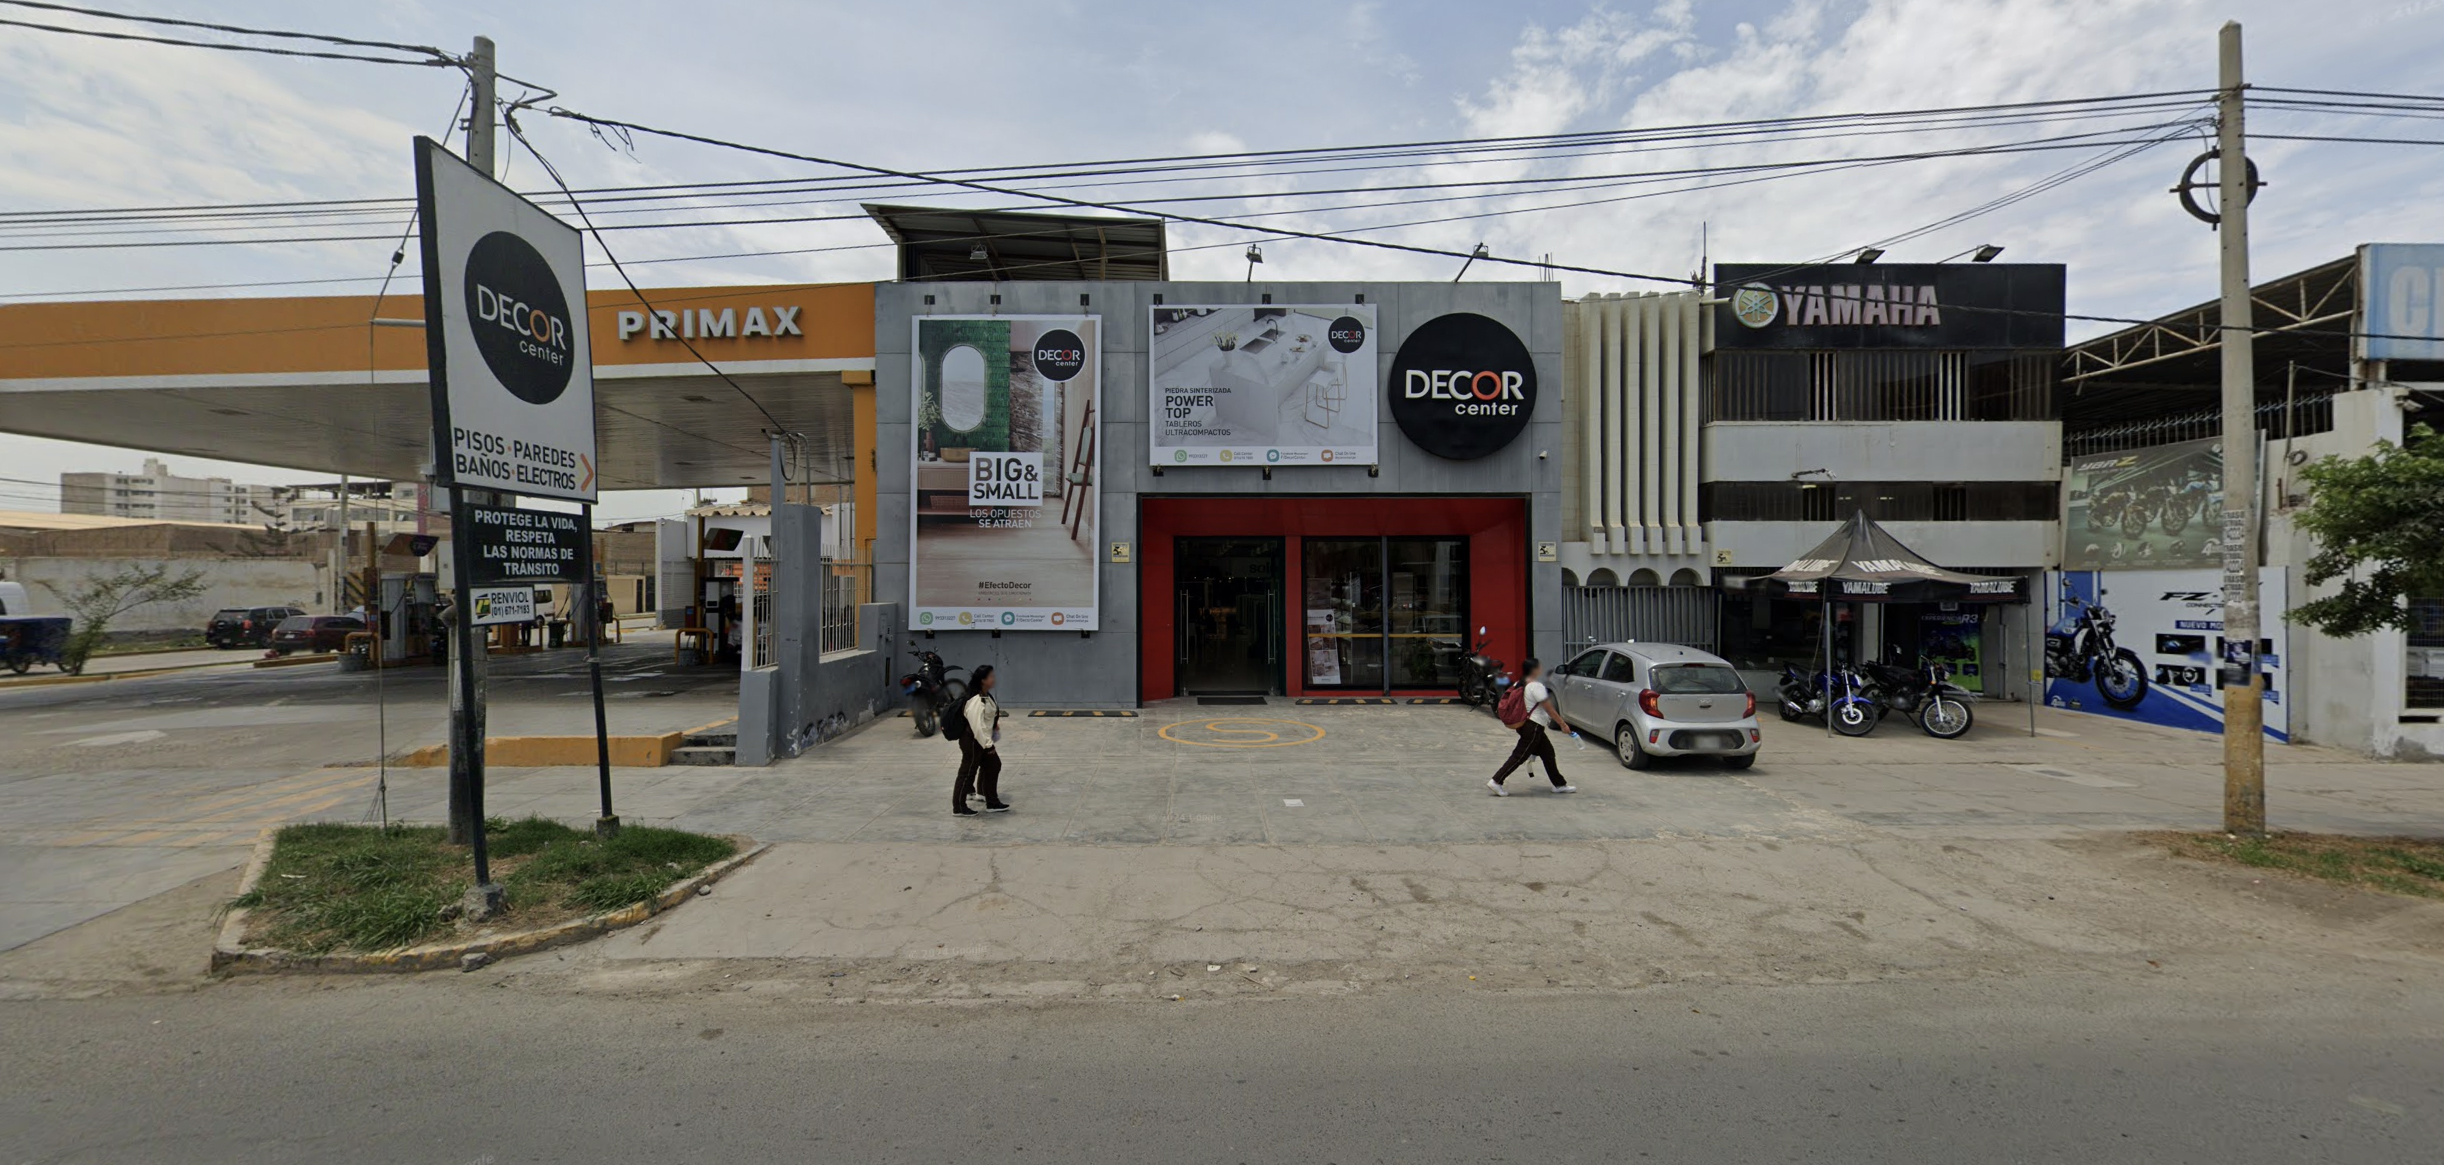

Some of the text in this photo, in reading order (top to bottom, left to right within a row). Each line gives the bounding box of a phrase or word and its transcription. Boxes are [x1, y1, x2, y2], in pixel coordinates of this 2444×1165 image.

[1781, 284, 1941, 326] YAMAHA
[477, 283, 567, 351] DECOR
[618, 306, 803, 341] PRIMAX
[1331, 330, 1362, 339] DECOR
[519, 340, 564, 366] center
[1038, 349, 1081, 361] DECOR
[1405, 369, 1525, 401] DECOR
[1165, 395, 1214, 407] POWER
[1165, 407, 1191, 419] TOP
[1454, 402, 1519, 416] center
[1165, 420, 1202, 428] TABLEROS
[1165, 428, 1231, 436] ULTRACOMPACTOS
[454, 427, 576, 469] PISOS PAREDES
[456, 453, 576, 490] BAÑOS ELECTROS
[975, 457, 1039, 482] BIG&
[973, 482, 1039, 500] SMALL
[969, 508, 1042, 519] LOS OPUESTOS
[474, 509, 578, 533] PROTEGE LA VIDA,
[978, 518, 1032, 528] SE ATRAEN
[505, 529, 556, 544] RESPETA
[483, 544, 574, 560] LAS NORMAS DE
[503, 560, 560, 575] TRÁNSITO
[978, 581, 1032, 589] #EfectoDecor
[1842, 582, 1889, 594] YAMALUBE
[1970, 581, 2015, 594] YAMALUBE
[491, 591, 529, 605] RENVIOL
[491, 604, 530, 618] (01) 671-7183
[1961, 613, 1979, 624] R3
[2180, 621, 2206, 629] NUEVO
